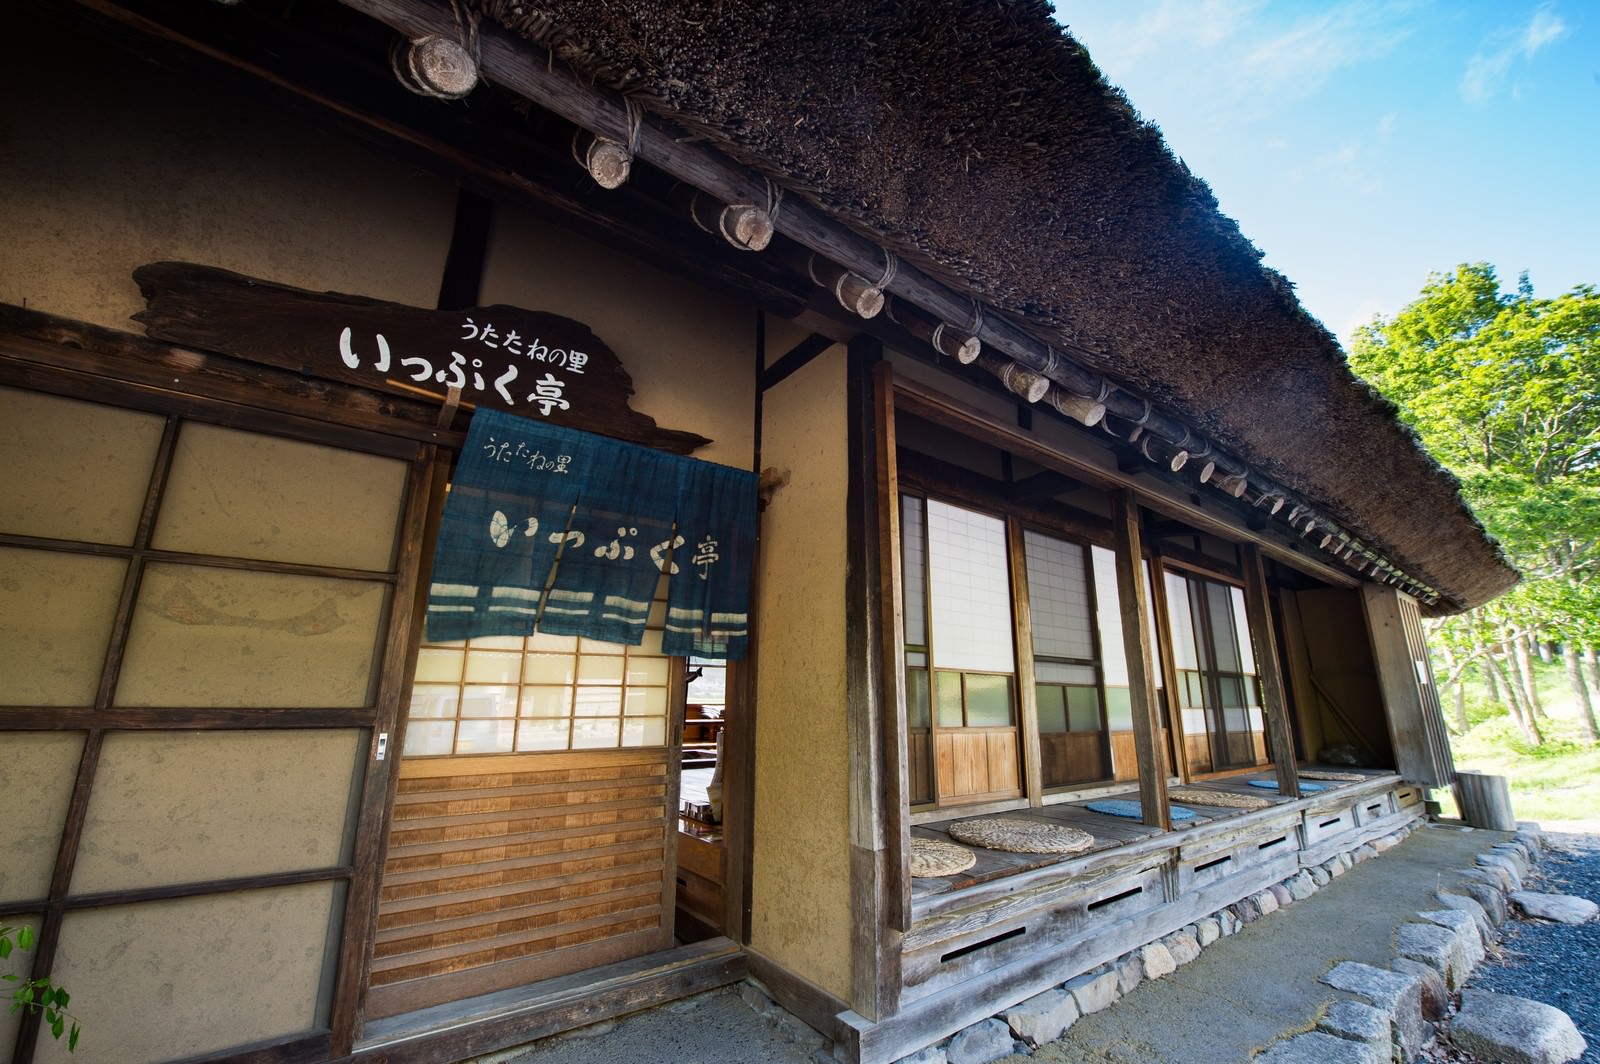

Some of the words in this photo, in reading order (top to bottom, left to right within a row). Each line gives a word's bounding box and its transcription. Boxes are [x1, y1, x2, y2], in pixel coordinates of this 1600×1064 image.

[339, 326, 570, 416] いっぷく亭
[461, 317, 588, 374] うたたねの里
[483, 437, 572, 474] うたたねの里
[489, 510, 719, 580] いっぷく亭
